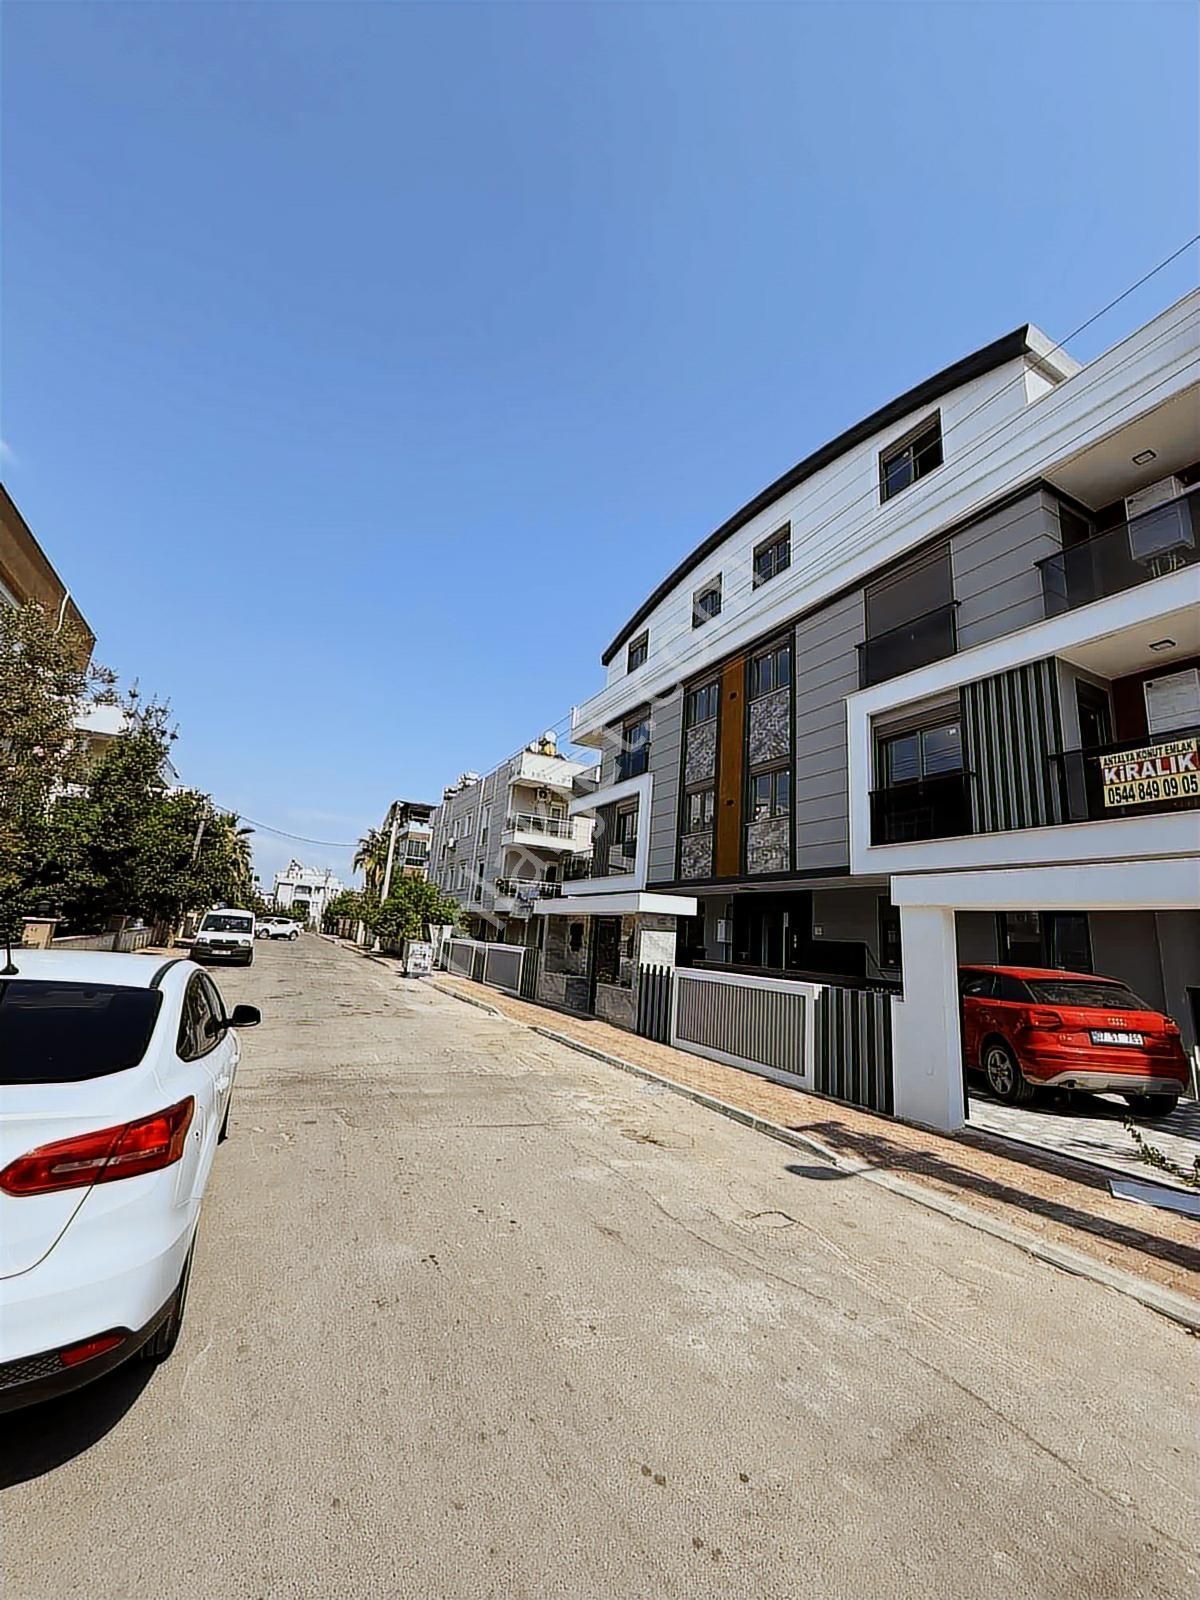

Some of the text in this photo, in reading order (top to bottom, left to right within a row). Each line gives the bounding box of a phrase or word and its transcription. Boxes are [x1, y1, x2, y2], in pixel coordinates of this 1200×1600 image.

[1165, 740, 1193, 753] EMLAK
[1108, 774, 1198, 805] 0544 849 09 05
